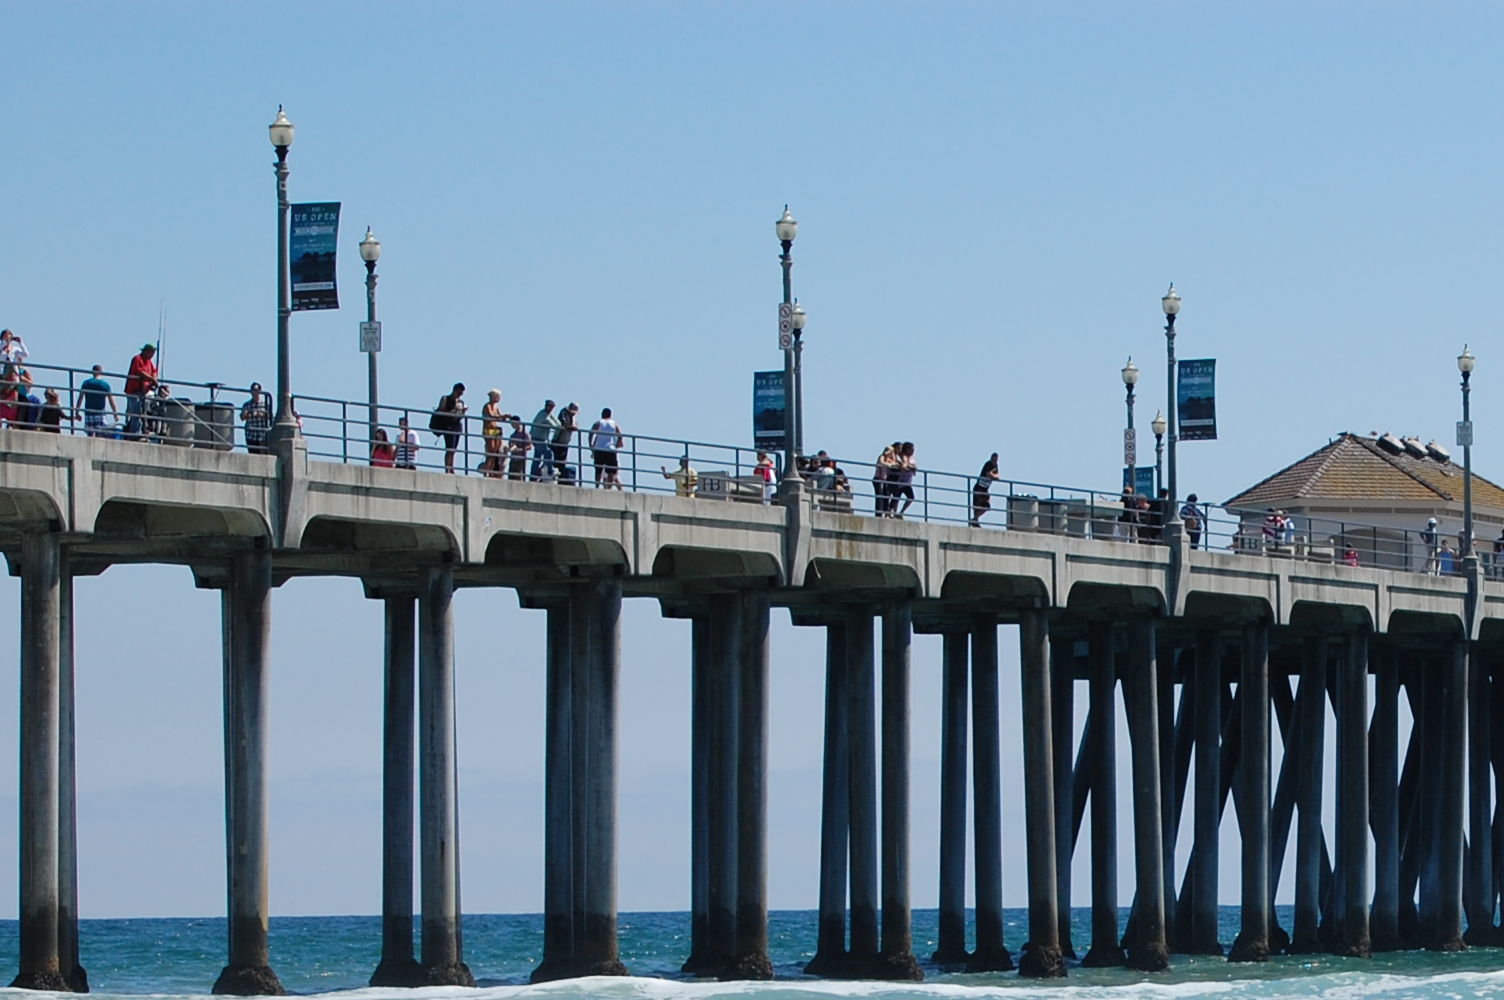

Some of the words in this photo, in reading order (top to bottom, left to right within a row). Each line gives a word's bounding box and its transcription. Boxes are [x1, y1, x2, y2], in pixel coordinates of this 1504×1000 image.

[294, 213, 307, 222] US
[310, 212, 337, 221] OPEN
[1193, 366, 1213, 374] OPEN
[702, 477, 721, 491] HB
